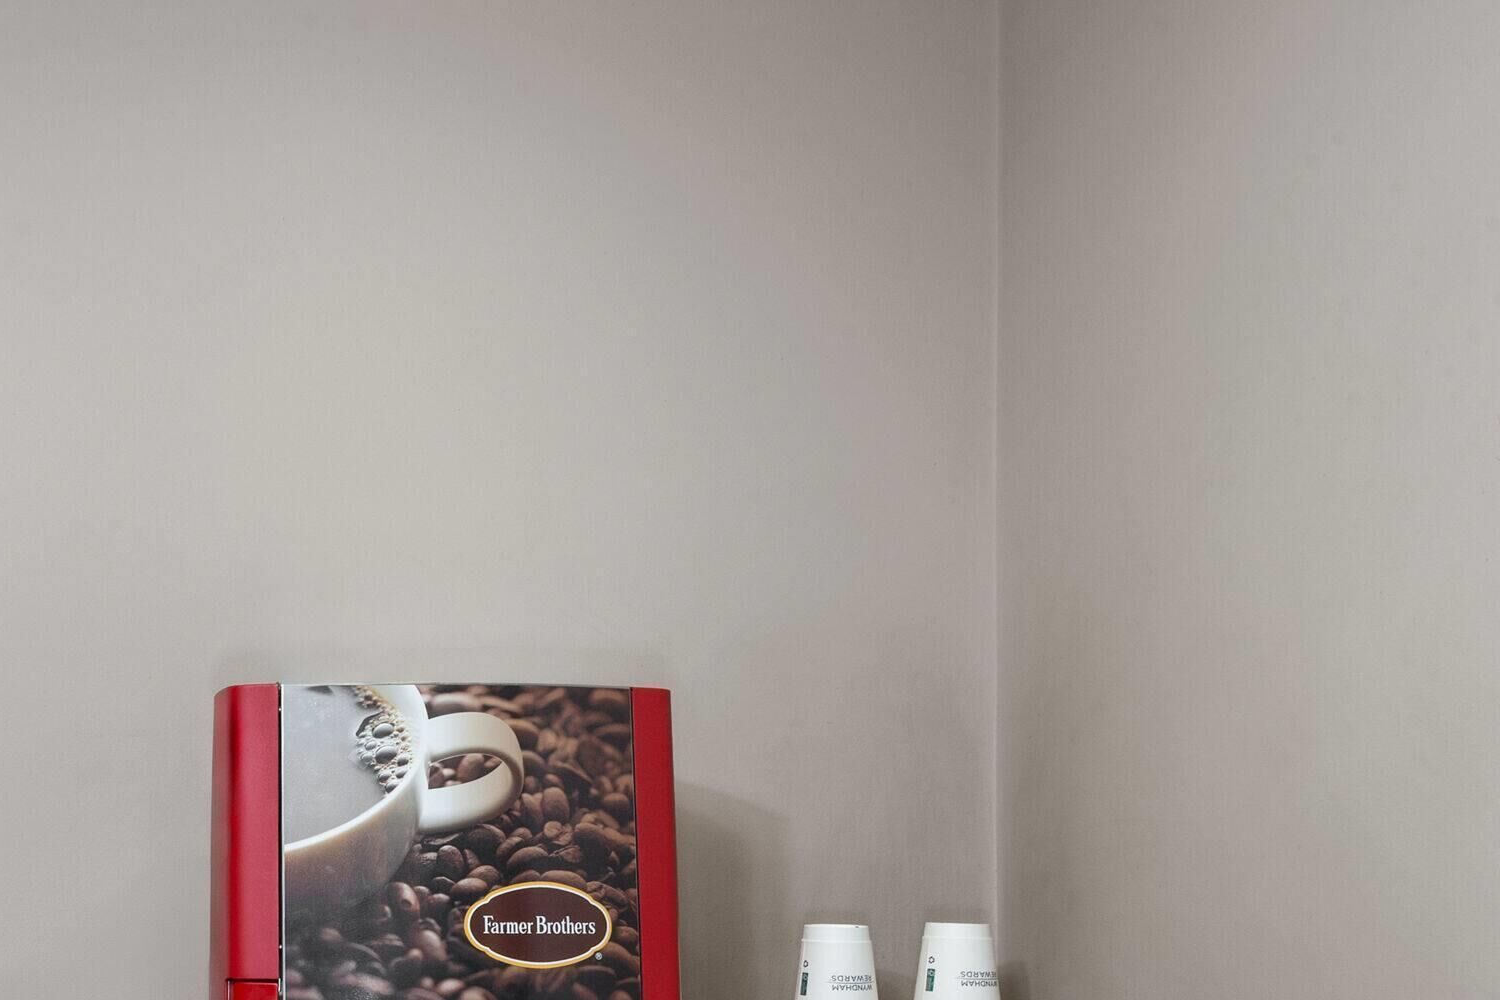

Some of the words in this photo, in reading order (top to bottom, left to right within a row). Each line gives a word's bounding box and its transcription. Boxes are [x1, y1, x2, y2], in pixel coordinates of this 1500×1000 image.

[482, 915, 533, 934] Farmer
[535, 915, 596, 935] Brothers
[831, 983, 873, 991] WYNDHAM
